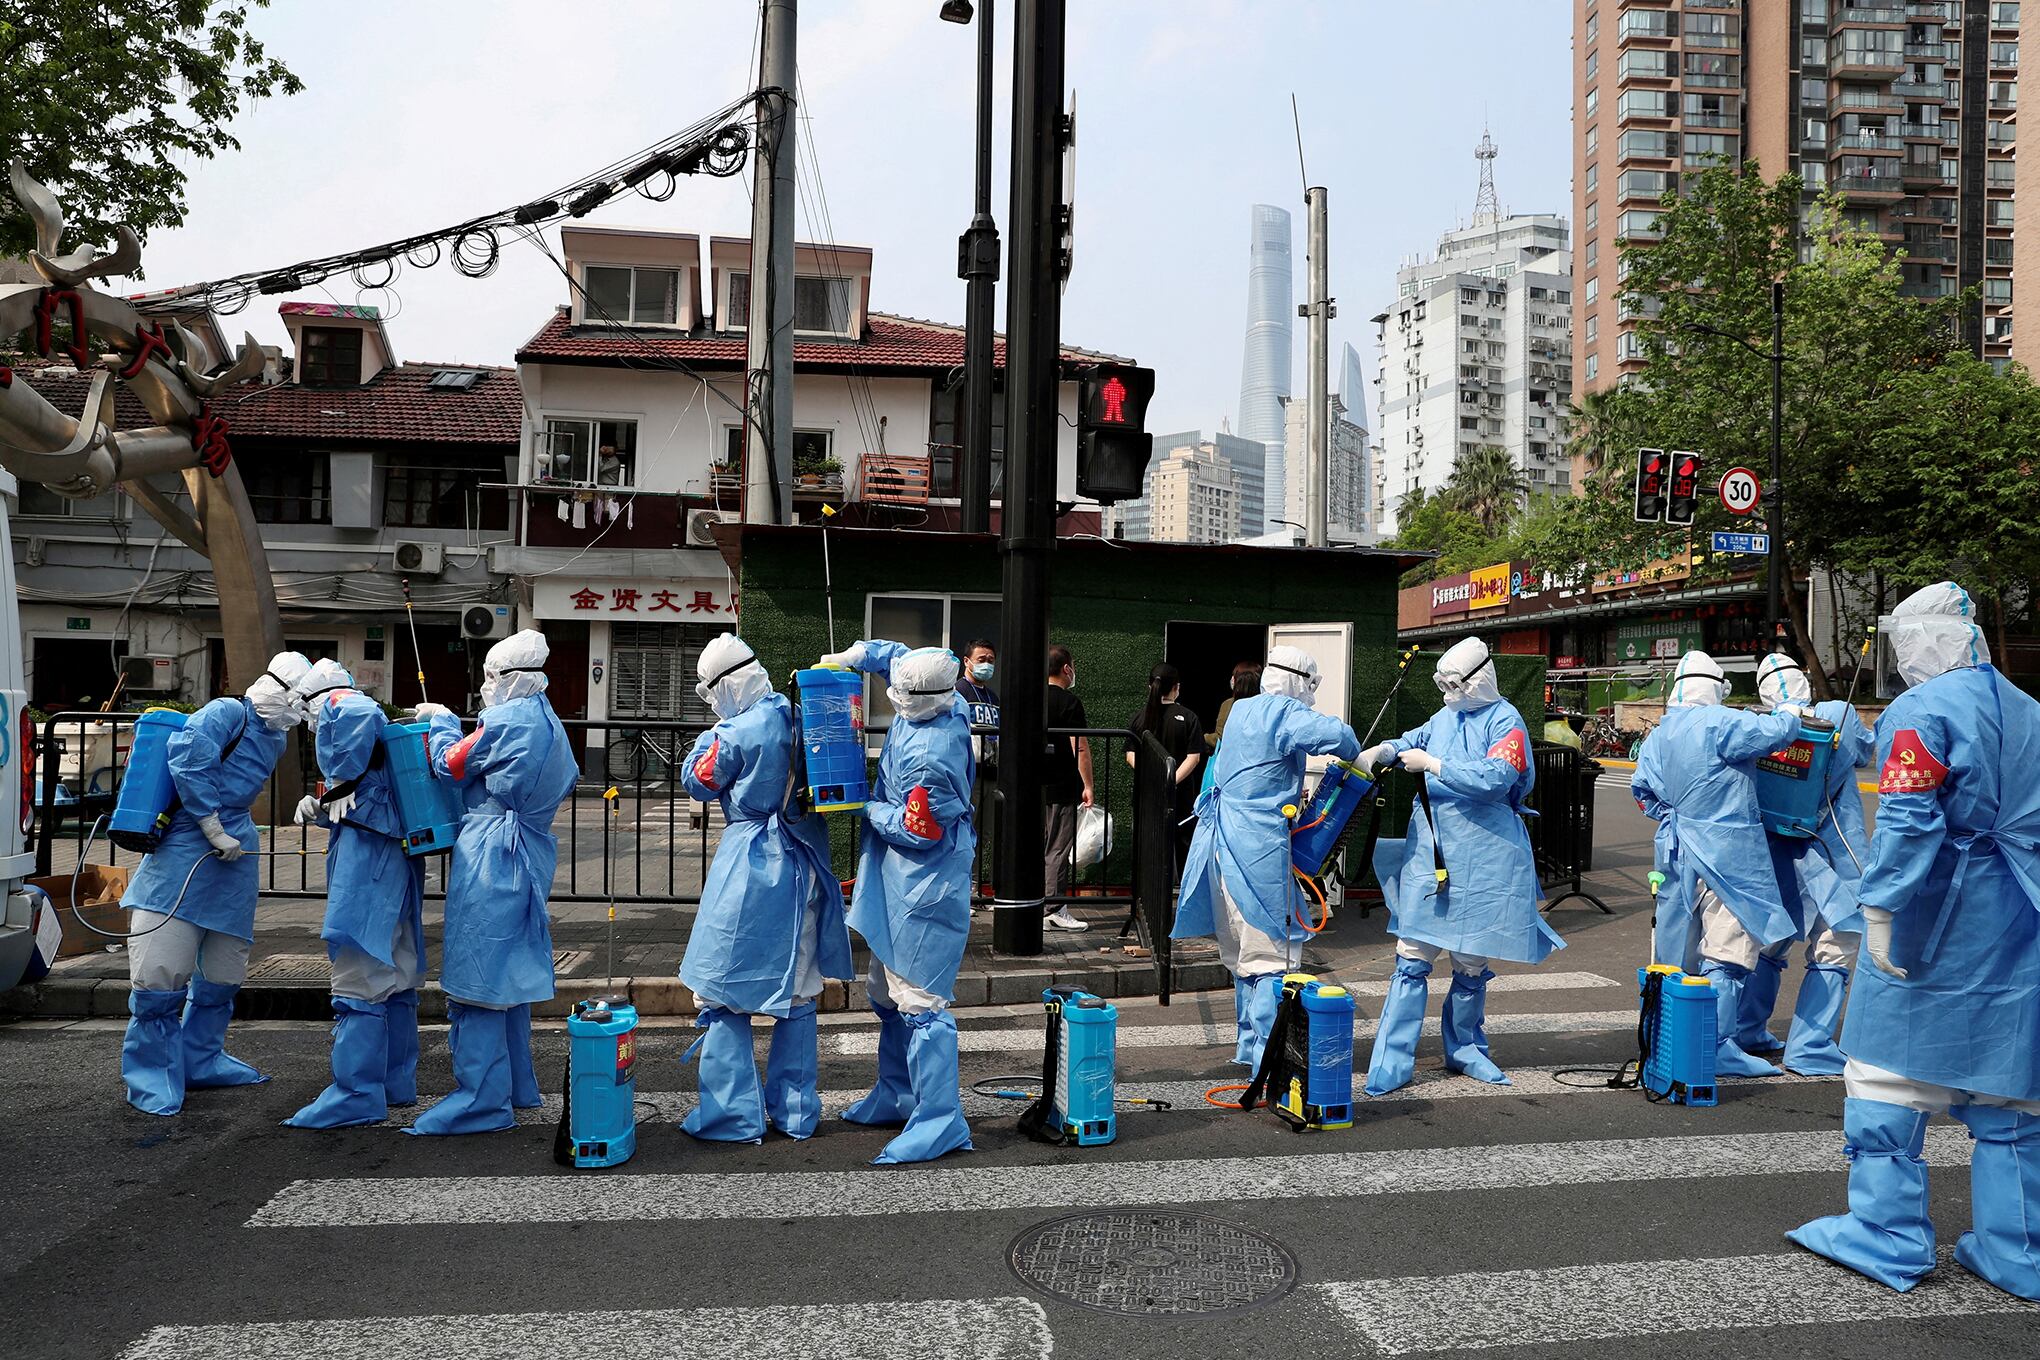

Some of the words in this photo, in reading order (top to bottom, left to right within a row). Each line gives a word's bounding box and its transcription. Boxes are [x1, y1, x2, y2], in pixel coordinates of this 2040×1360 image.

[1729, 480, 1752, 502] 30
[974, 704, 999, 725] GAP
[1771, 746, 1812, 763] 消防
